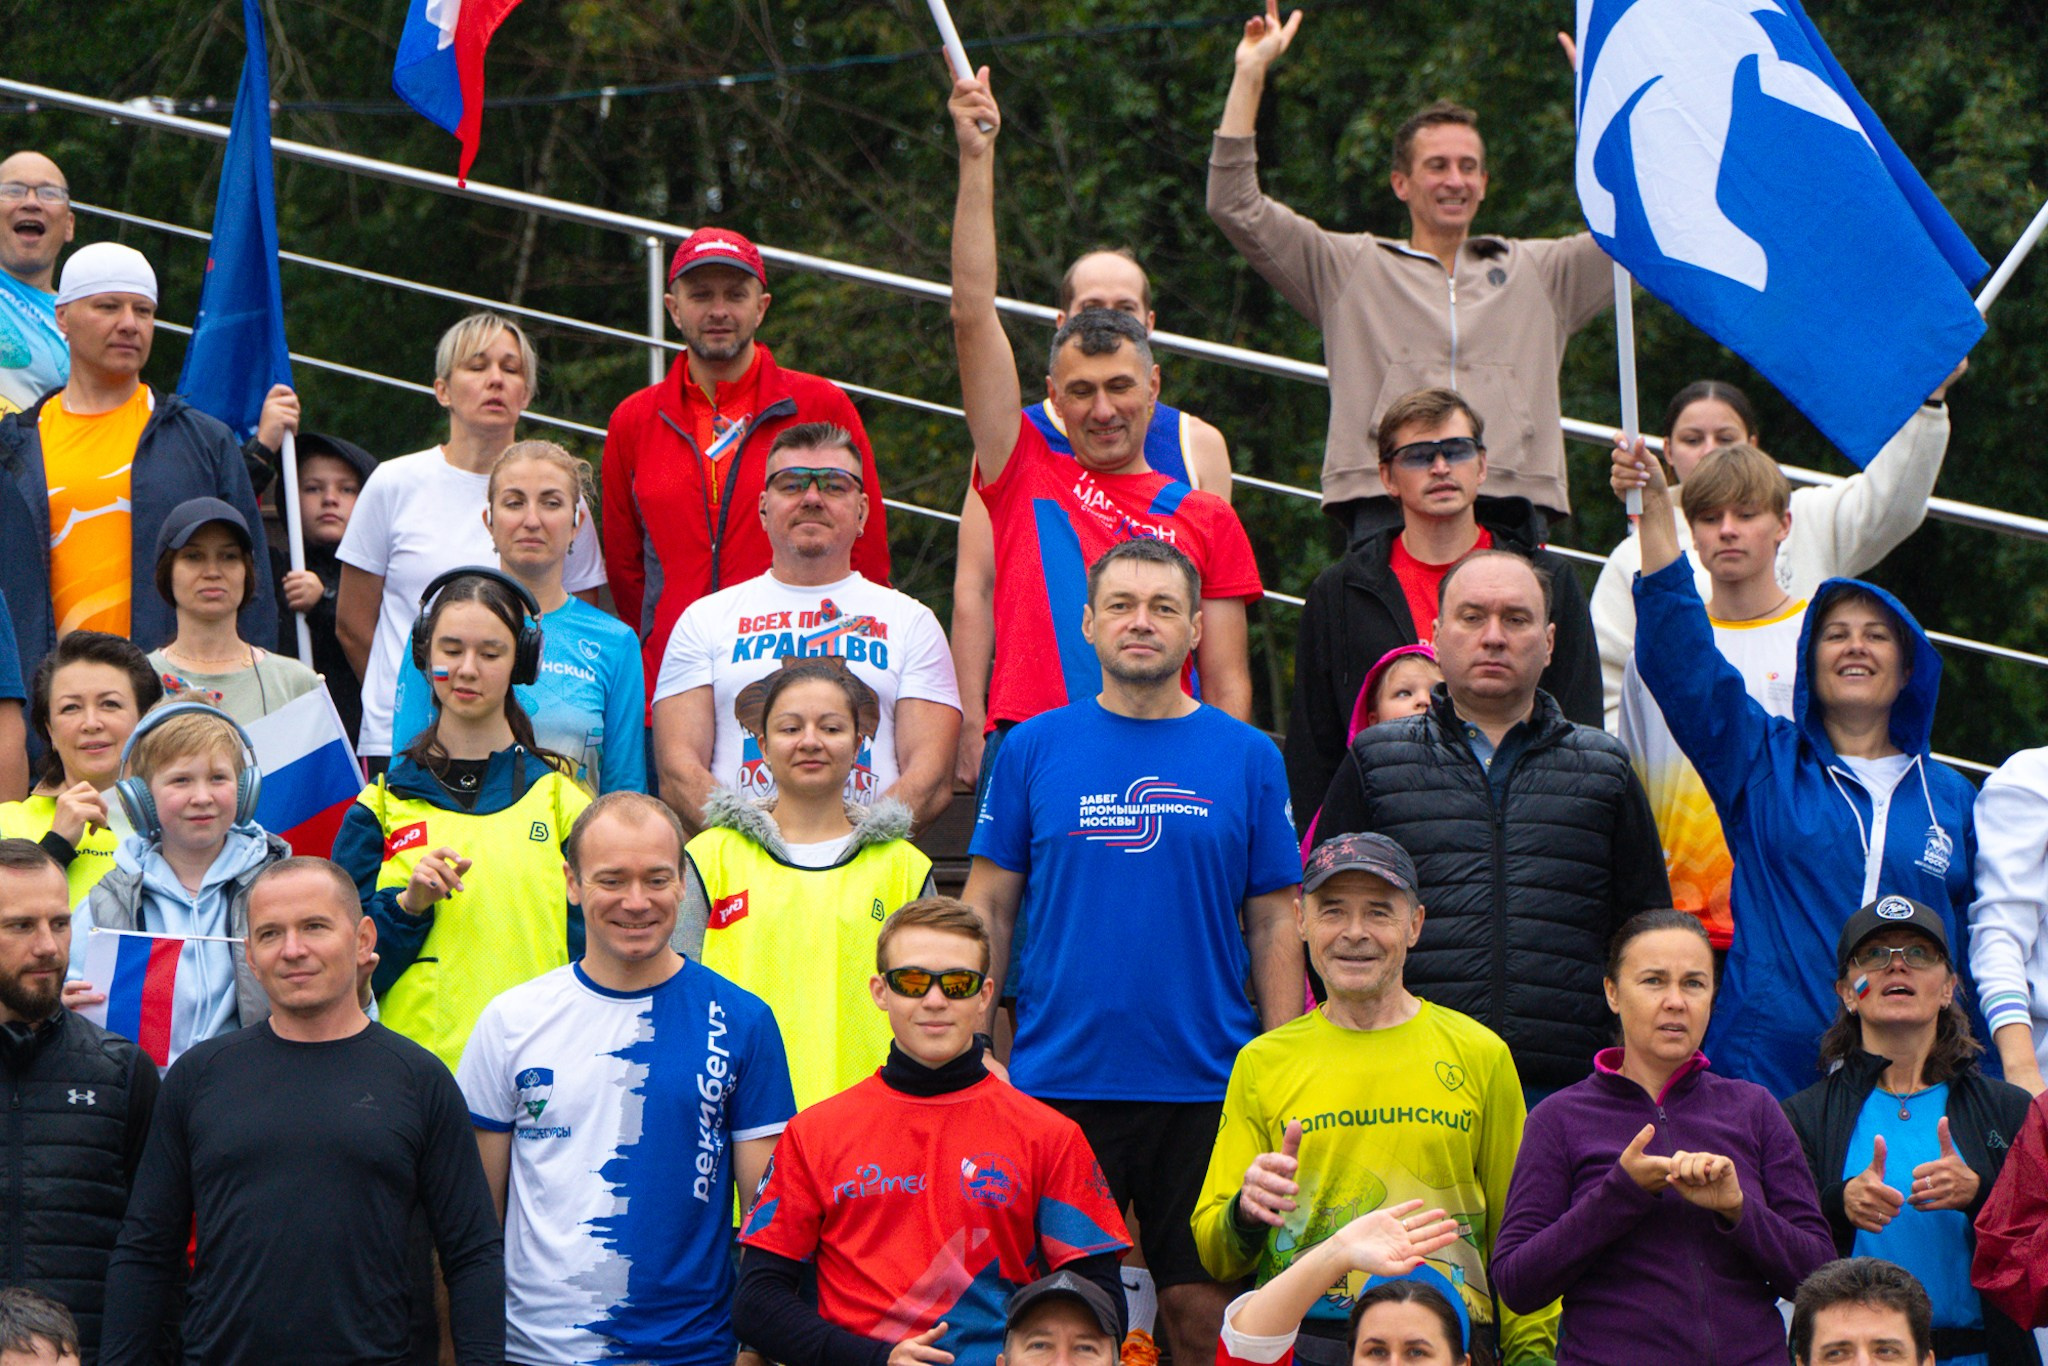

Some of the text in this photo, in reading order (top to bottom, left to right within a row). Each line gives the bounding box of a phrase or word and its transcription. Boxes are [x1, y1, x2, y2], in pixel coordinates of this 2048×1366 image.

[738, 611, 792, 635] ВСЕХ
[1079, 793, 1118, 806] ЗАБЕГ
[1079, 803, 1209, 818] ПРОМЫШЛЕННОСТИ
[1079, 816, 1137, 828] МОСКВЫ
